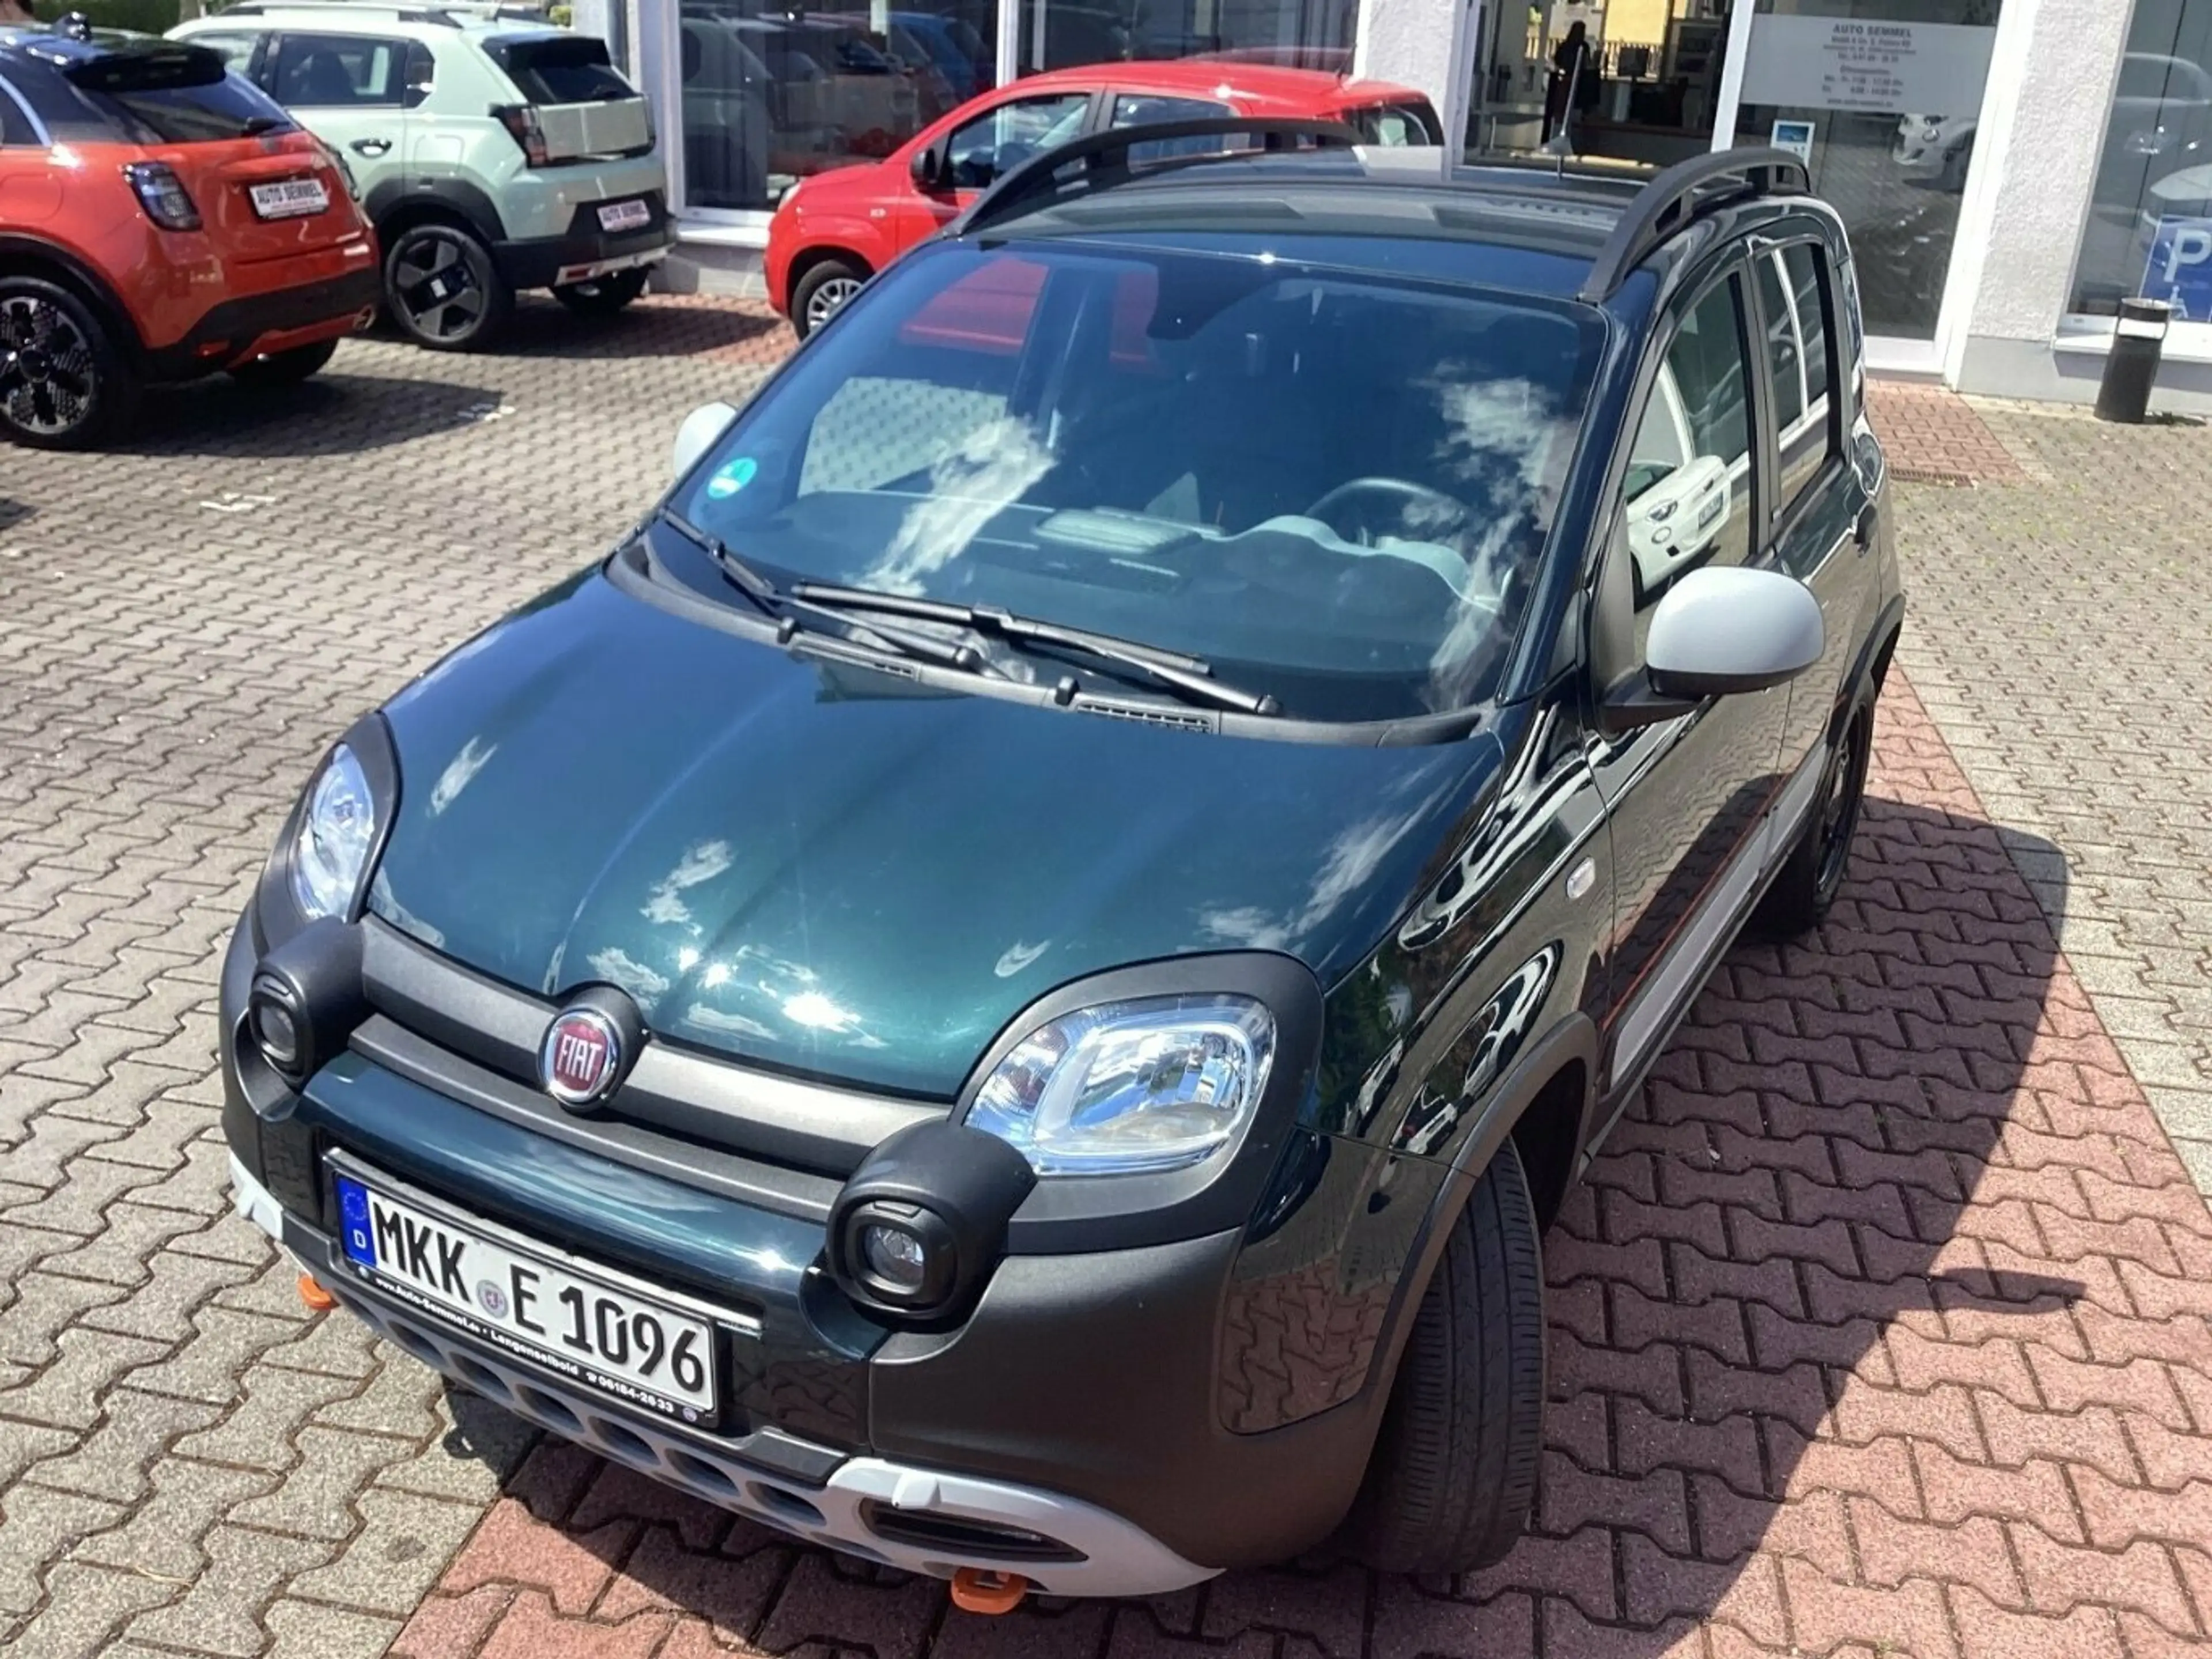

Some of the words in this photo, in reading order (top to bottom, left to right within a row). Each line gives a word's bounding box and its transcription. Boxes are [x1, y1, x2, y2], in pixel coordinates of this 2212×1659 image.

[1833, 24, 1864, 35] AUTO
[256, 187, 282, 204] AUTO
[2164, 228, 2212, 283] P
[557, 1034, 602, 1081] FIAT
[353, 1229, 367, 1249] D
[373, 1201, 472, 1304] MKK
[510, 1263, 545, 1335] E
[559, 1285, 704, 1393] 1096
[491, 1330, 578, 1376] Langenselbold
